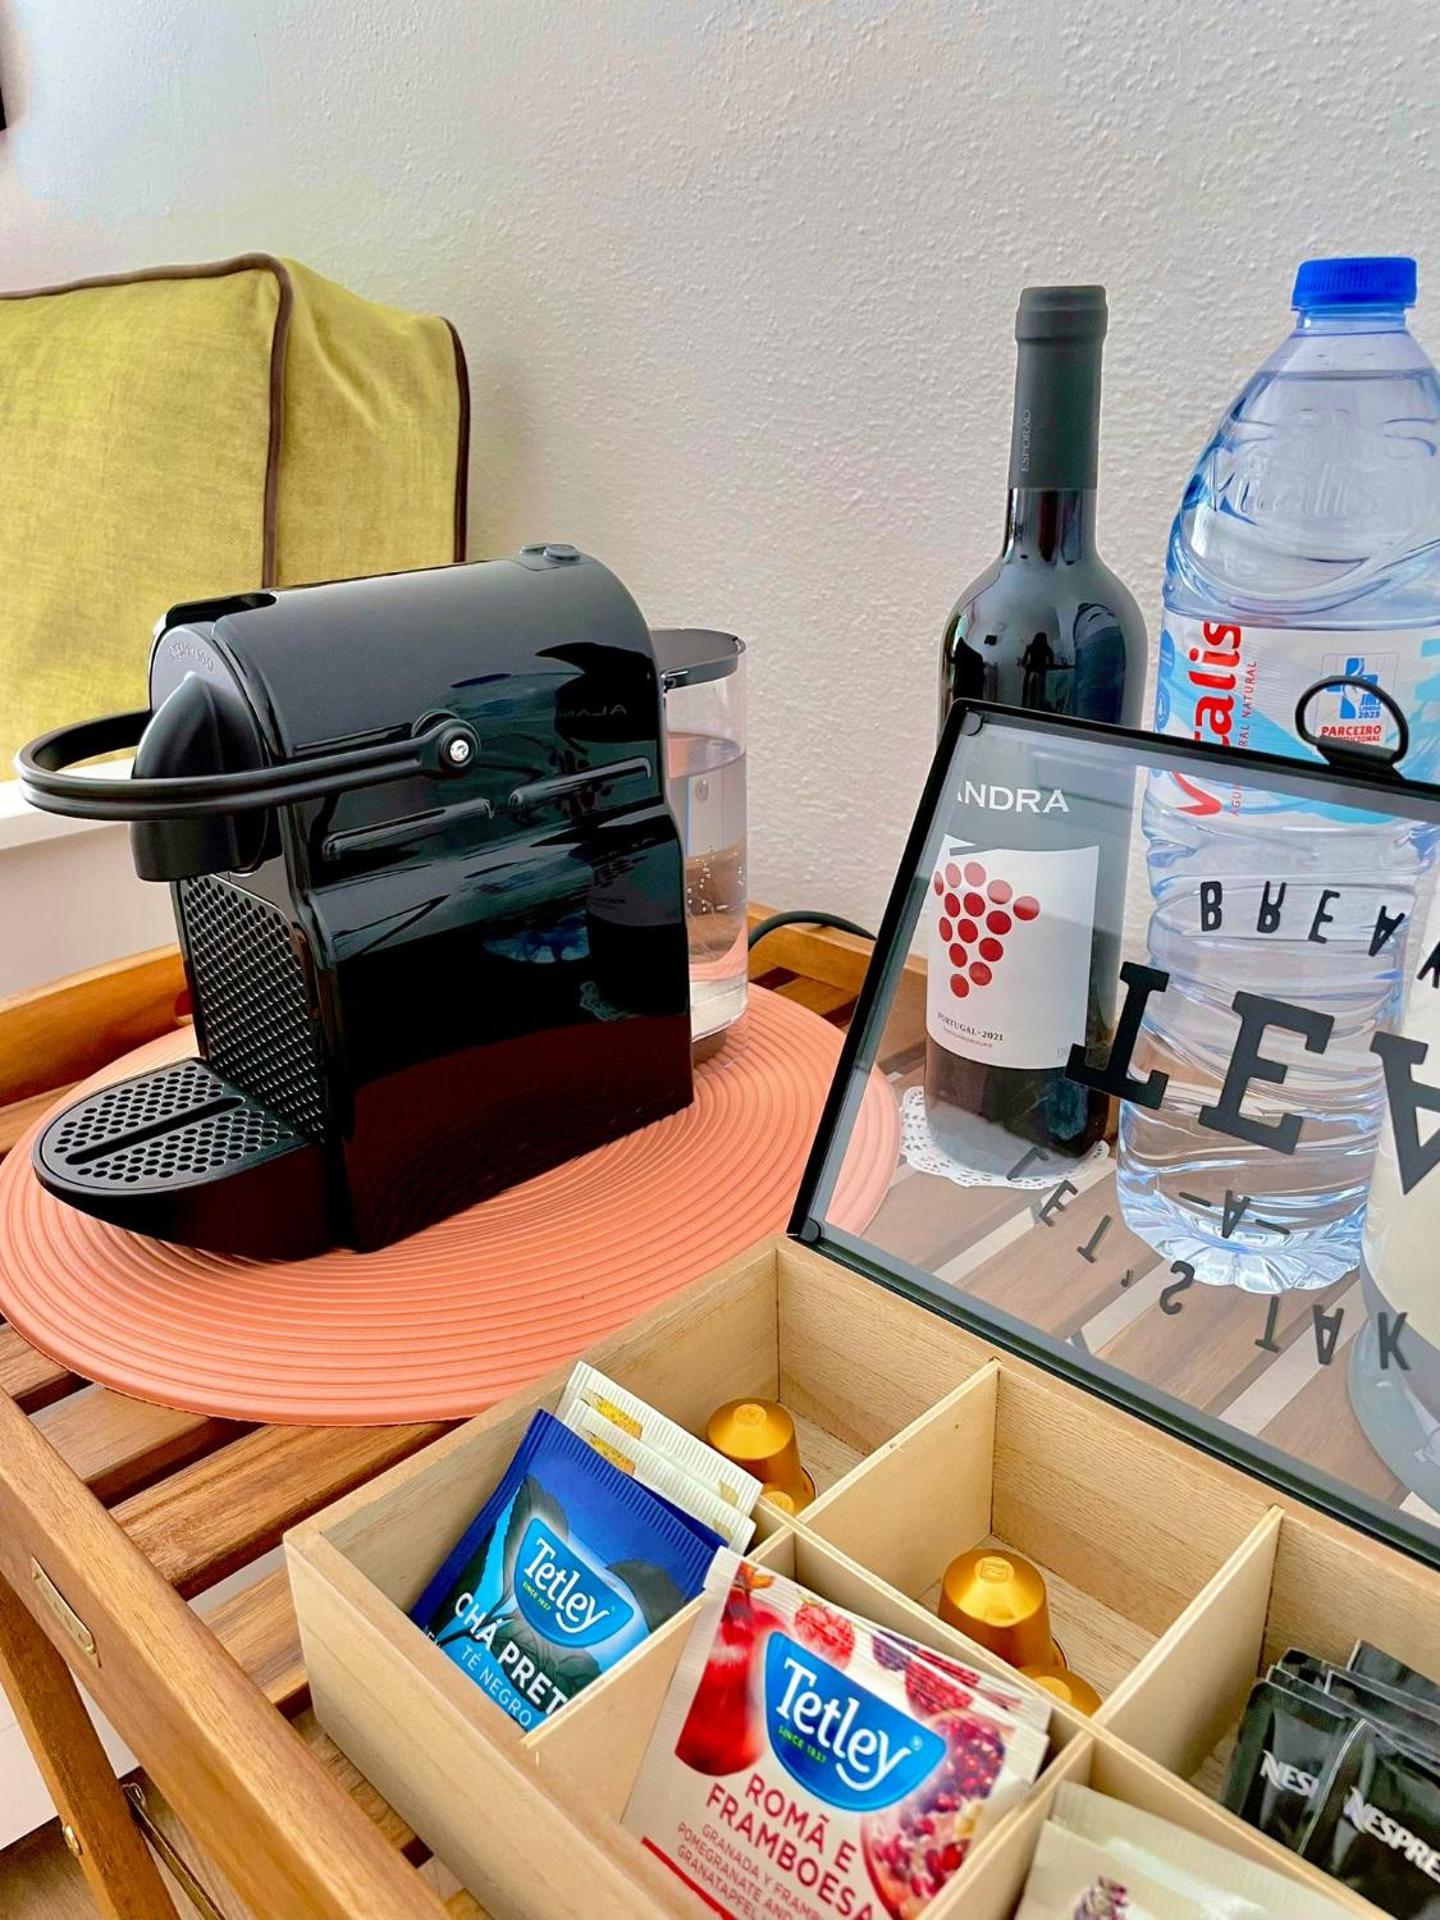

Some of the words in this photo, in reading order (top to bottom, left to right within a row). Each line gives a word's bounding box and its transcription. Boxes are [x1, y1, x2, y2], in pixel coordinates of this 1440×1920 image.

[1241, 661, 1257, 719] NATURAL
[1321, 725, 1382, 737] PARCEIRO
[957, 781, 1069, 813] NDRA
[982, 1030, 1004, 1042] 2021
[524, 1537, 610, 1634] Tetley
[455, 1592, 503, 1651] CHÁ
[497, 1641, 569, 1715] PRET
[461, 1646, 482, 1671] TÉ
[480, 1667, 532, 1726] NEGRO
[774, 1657, 912, 1792] Tetley
[677, 1822, 763, 1901] POMEGRANATE
[706, 1782, 874, 1920] FRAMBOESA
[745, 1773, 830, 1854] ROMÃ
[834, 1839, 857, 1874] E
[1343, 1786, 1440, 1884] NESPRE
[702, 1824, 760, 1880] GRANADA
[763, 1871, 773, 1885] Y
[774, 1880, 822, 1920] FRAMB
